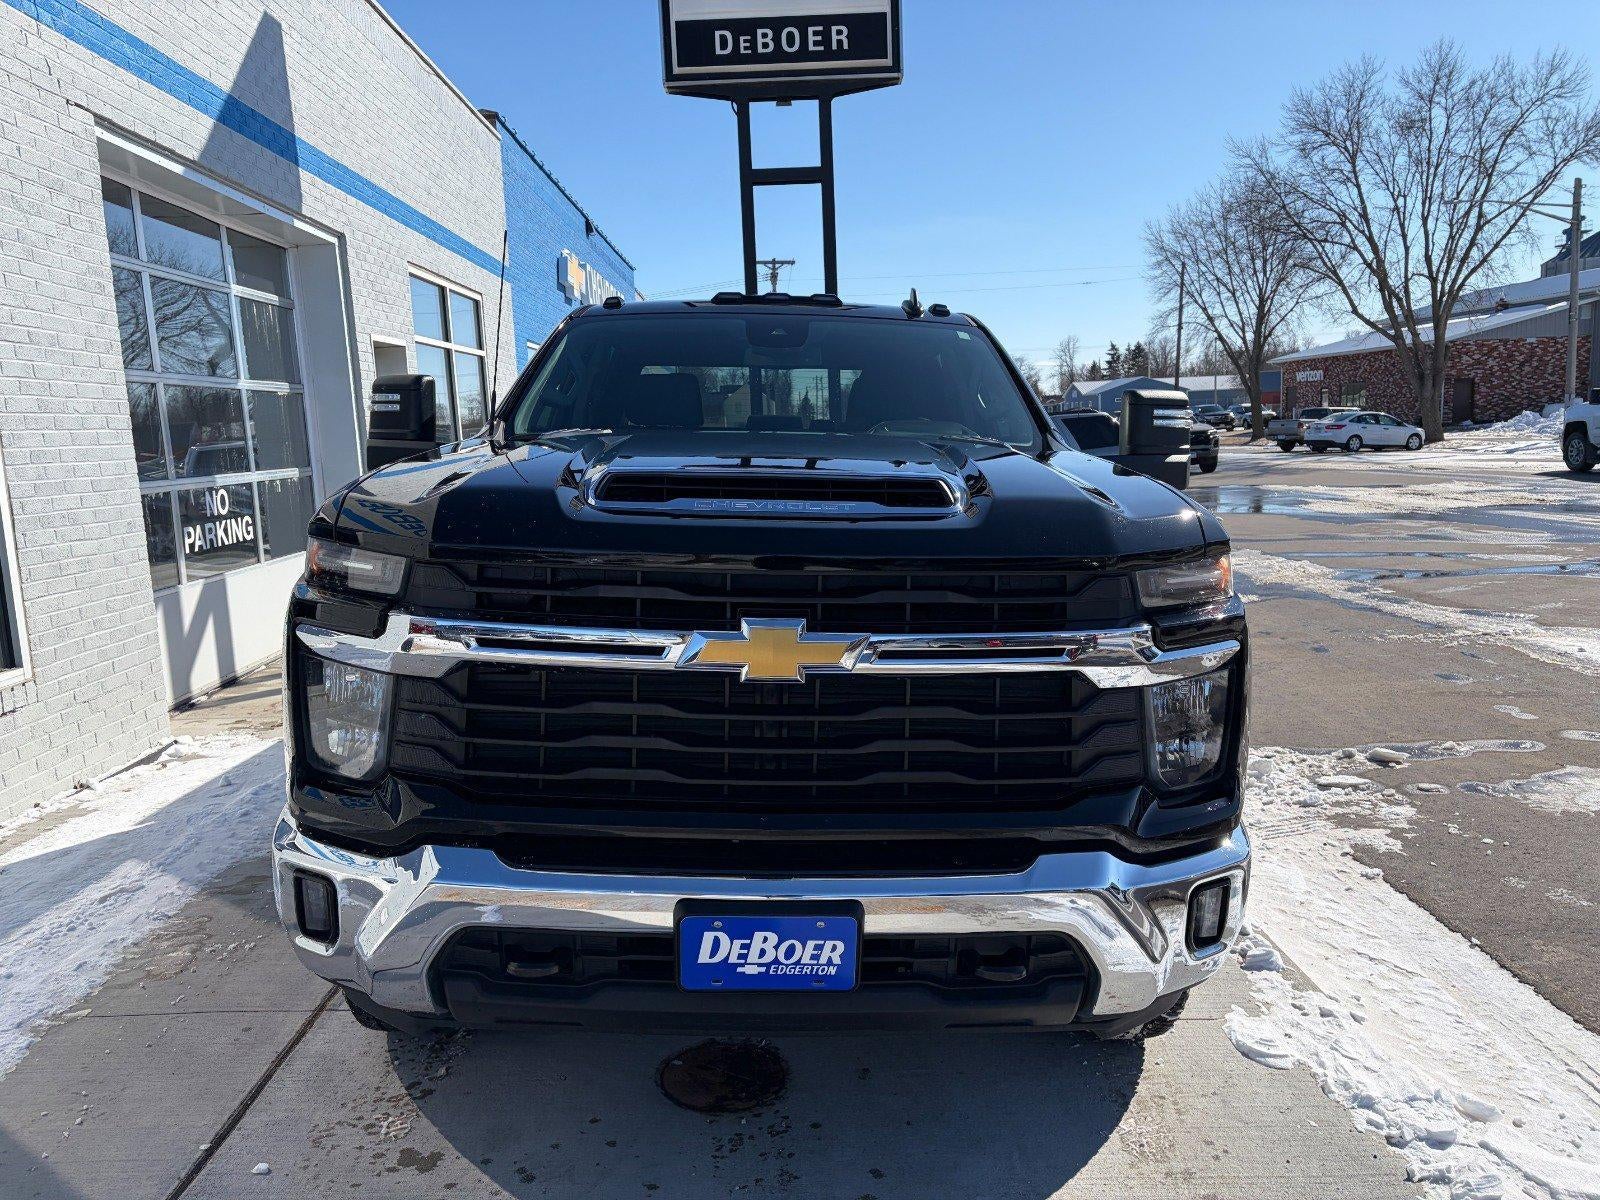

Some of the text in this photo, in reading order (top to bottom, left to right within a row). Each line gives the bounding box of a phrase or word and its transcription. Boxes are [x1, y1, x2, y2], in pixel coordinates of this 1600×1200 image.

[1295, 368, 1324, 382] verizon
[205, 488, 229, 517] NO
[694, 500, 856, 511] CHEVROLET
[183, 515, 255, 554] PARKING
[769, 965, 837, 976] EDGERTON
